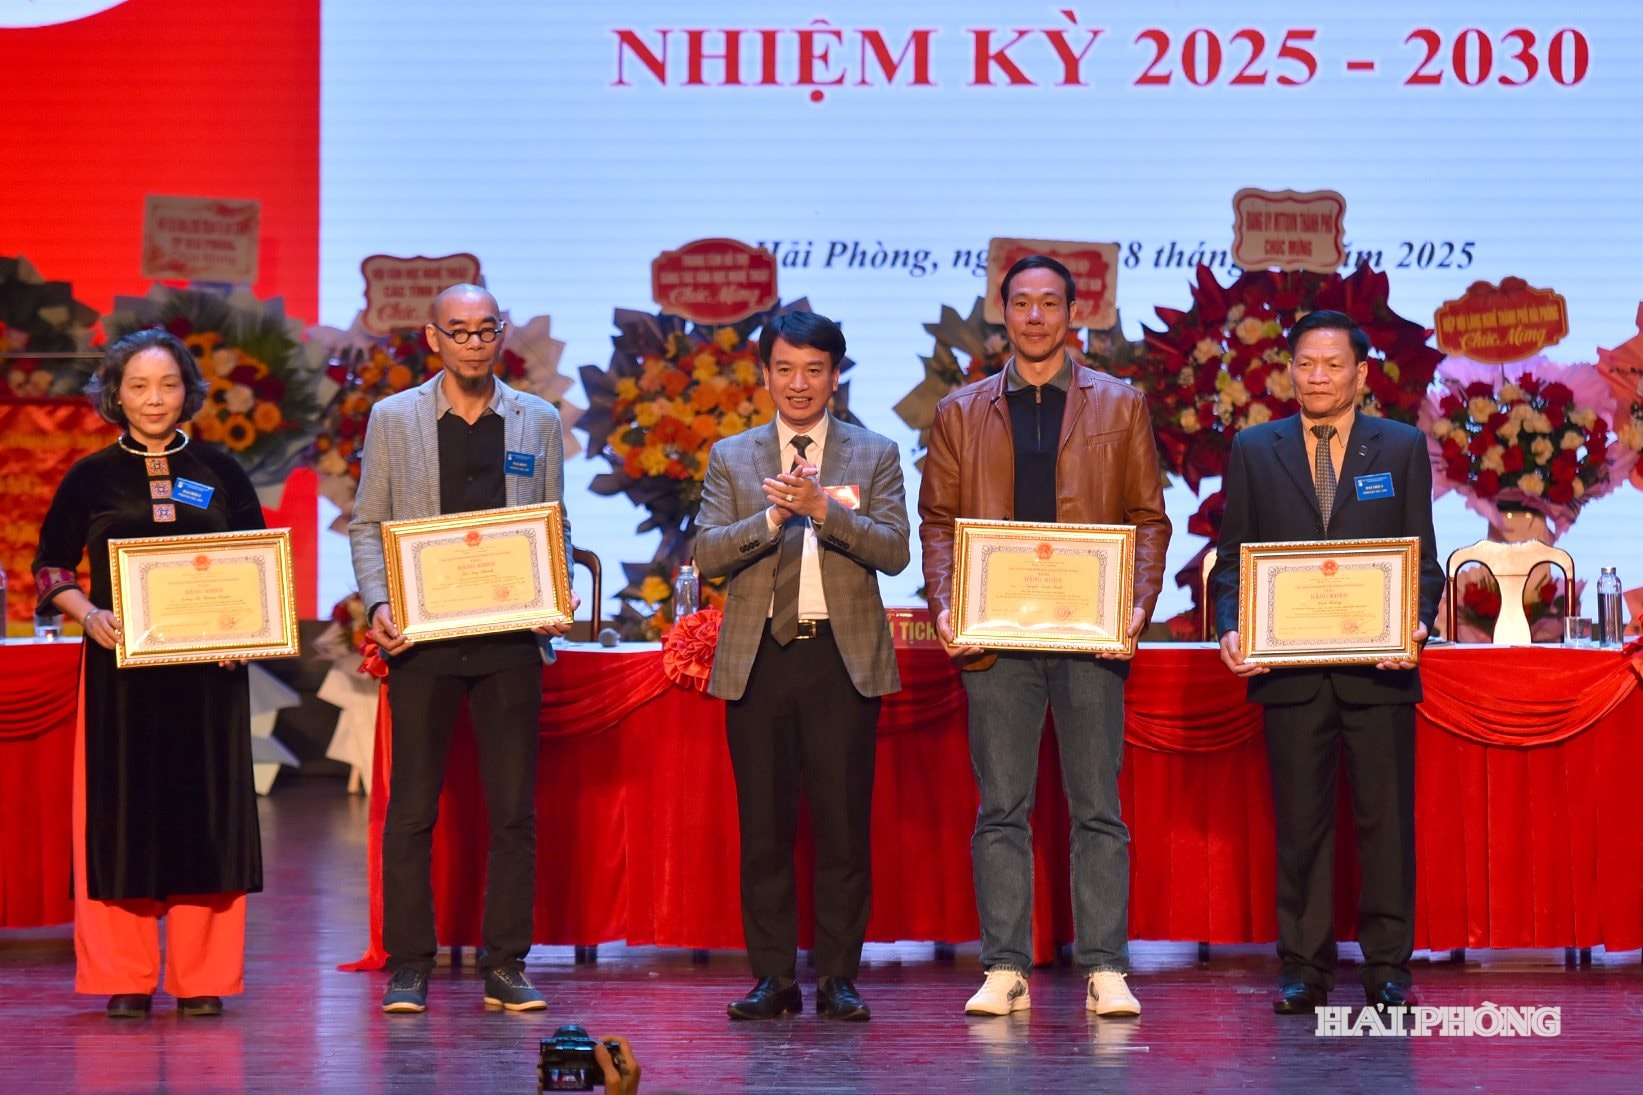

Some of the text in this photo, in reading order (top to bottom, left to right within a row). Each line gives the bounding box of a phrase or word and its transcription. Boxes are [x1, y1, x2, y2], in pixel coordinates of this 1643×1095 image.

[610, 10, 1589, 102] NHIỆM KỲ 2025 - 2030
[822, 240, 938, 278] Phòng,
[1113, 242, 1142, 269] 8
[1396, 241, 1475, 270] 2025
